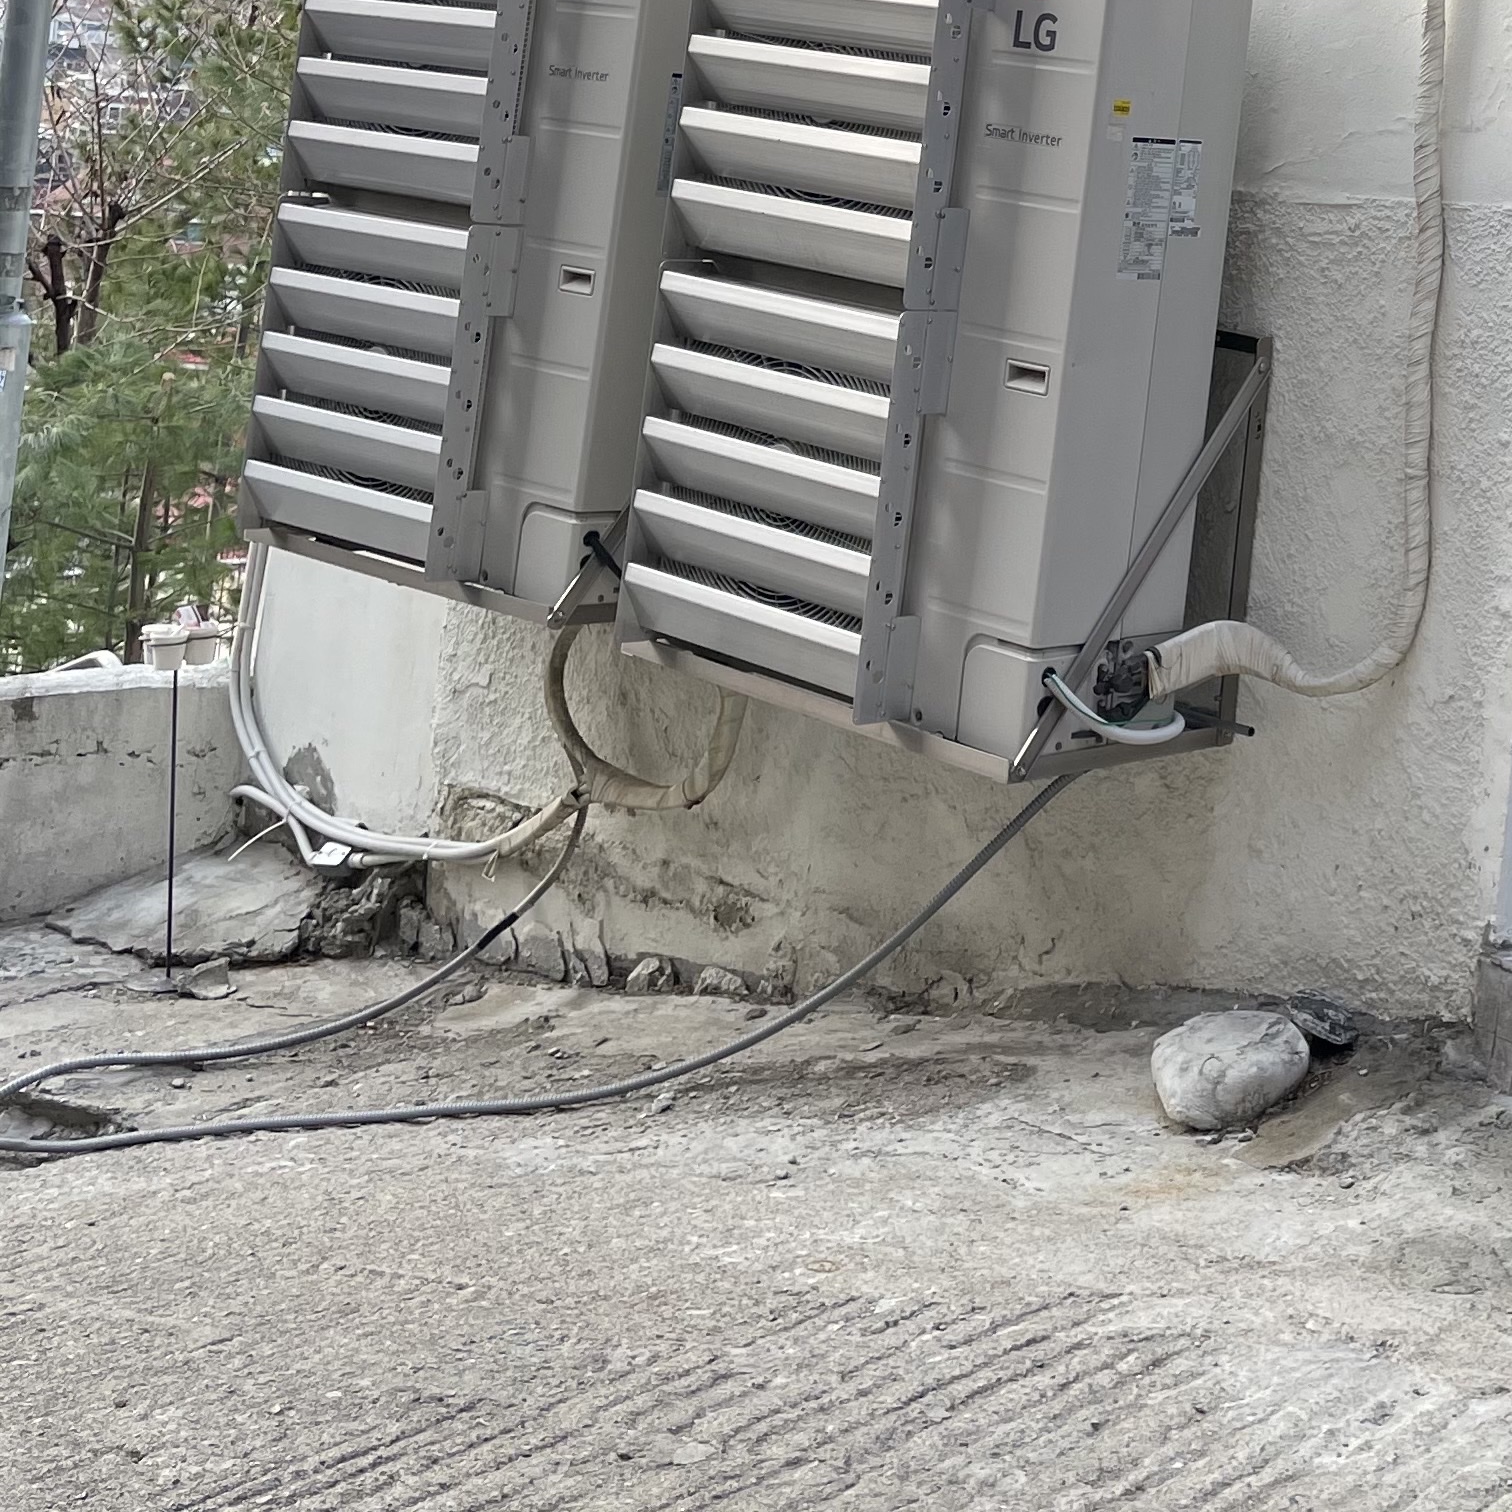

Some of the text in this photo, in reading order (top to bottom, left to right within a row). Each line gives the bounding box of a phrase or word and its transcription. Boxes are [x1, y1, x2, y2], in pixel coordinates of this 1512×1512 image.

[1012, 9, 1059, 52] LG
[548, 64, 609, 82] Smart Inverter
[984, 123, 1063, 147] Smart Inverter
